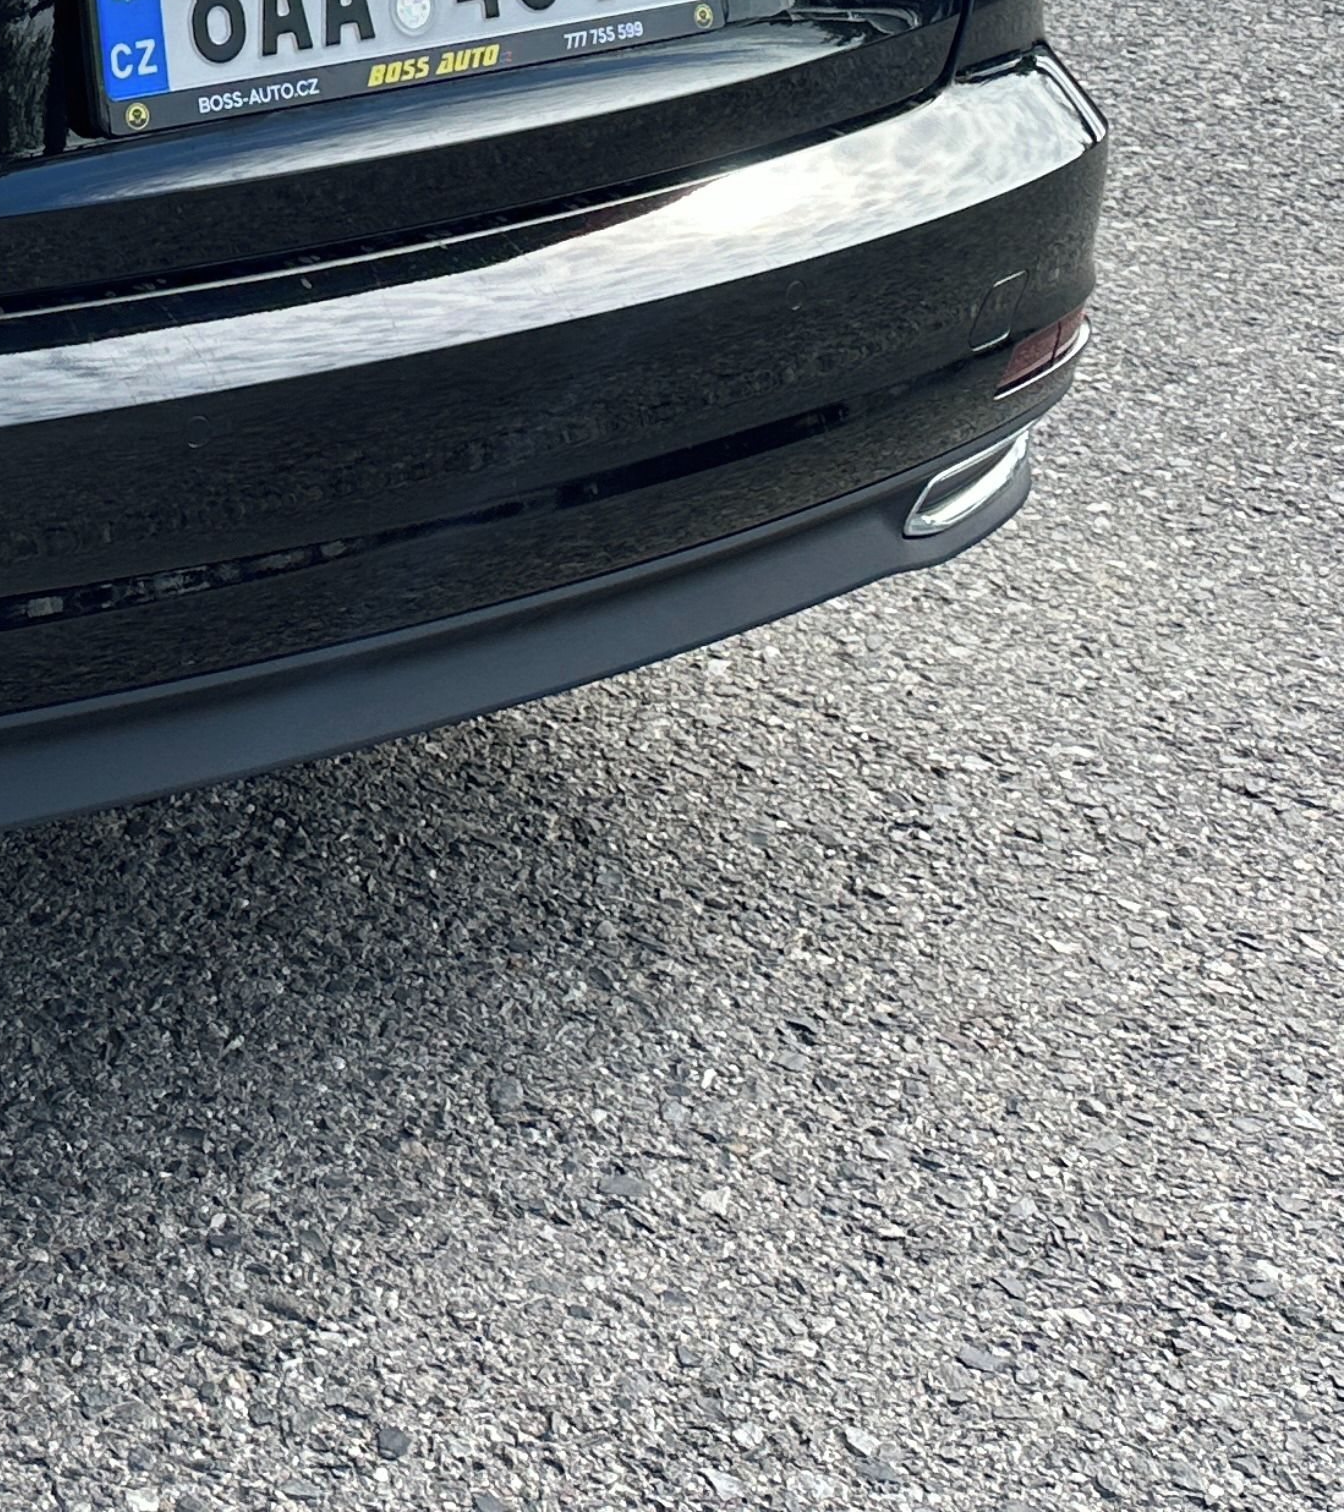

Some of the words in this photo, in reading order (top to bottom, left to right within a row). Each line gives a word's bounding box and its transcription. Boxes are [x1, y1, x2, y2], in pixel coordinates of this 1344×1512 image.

[563, 30, 588, 50] 777
[590, 26, 615, 44] 755
[617, 20, 644, 40] 599
[109, 39, 158, 79] CZ
[367, 54, 430, 88] BOSS
[436, 44, 500, 76] AUTO
[198, 78, 320, 115] BOSS-AUTO.CZ
